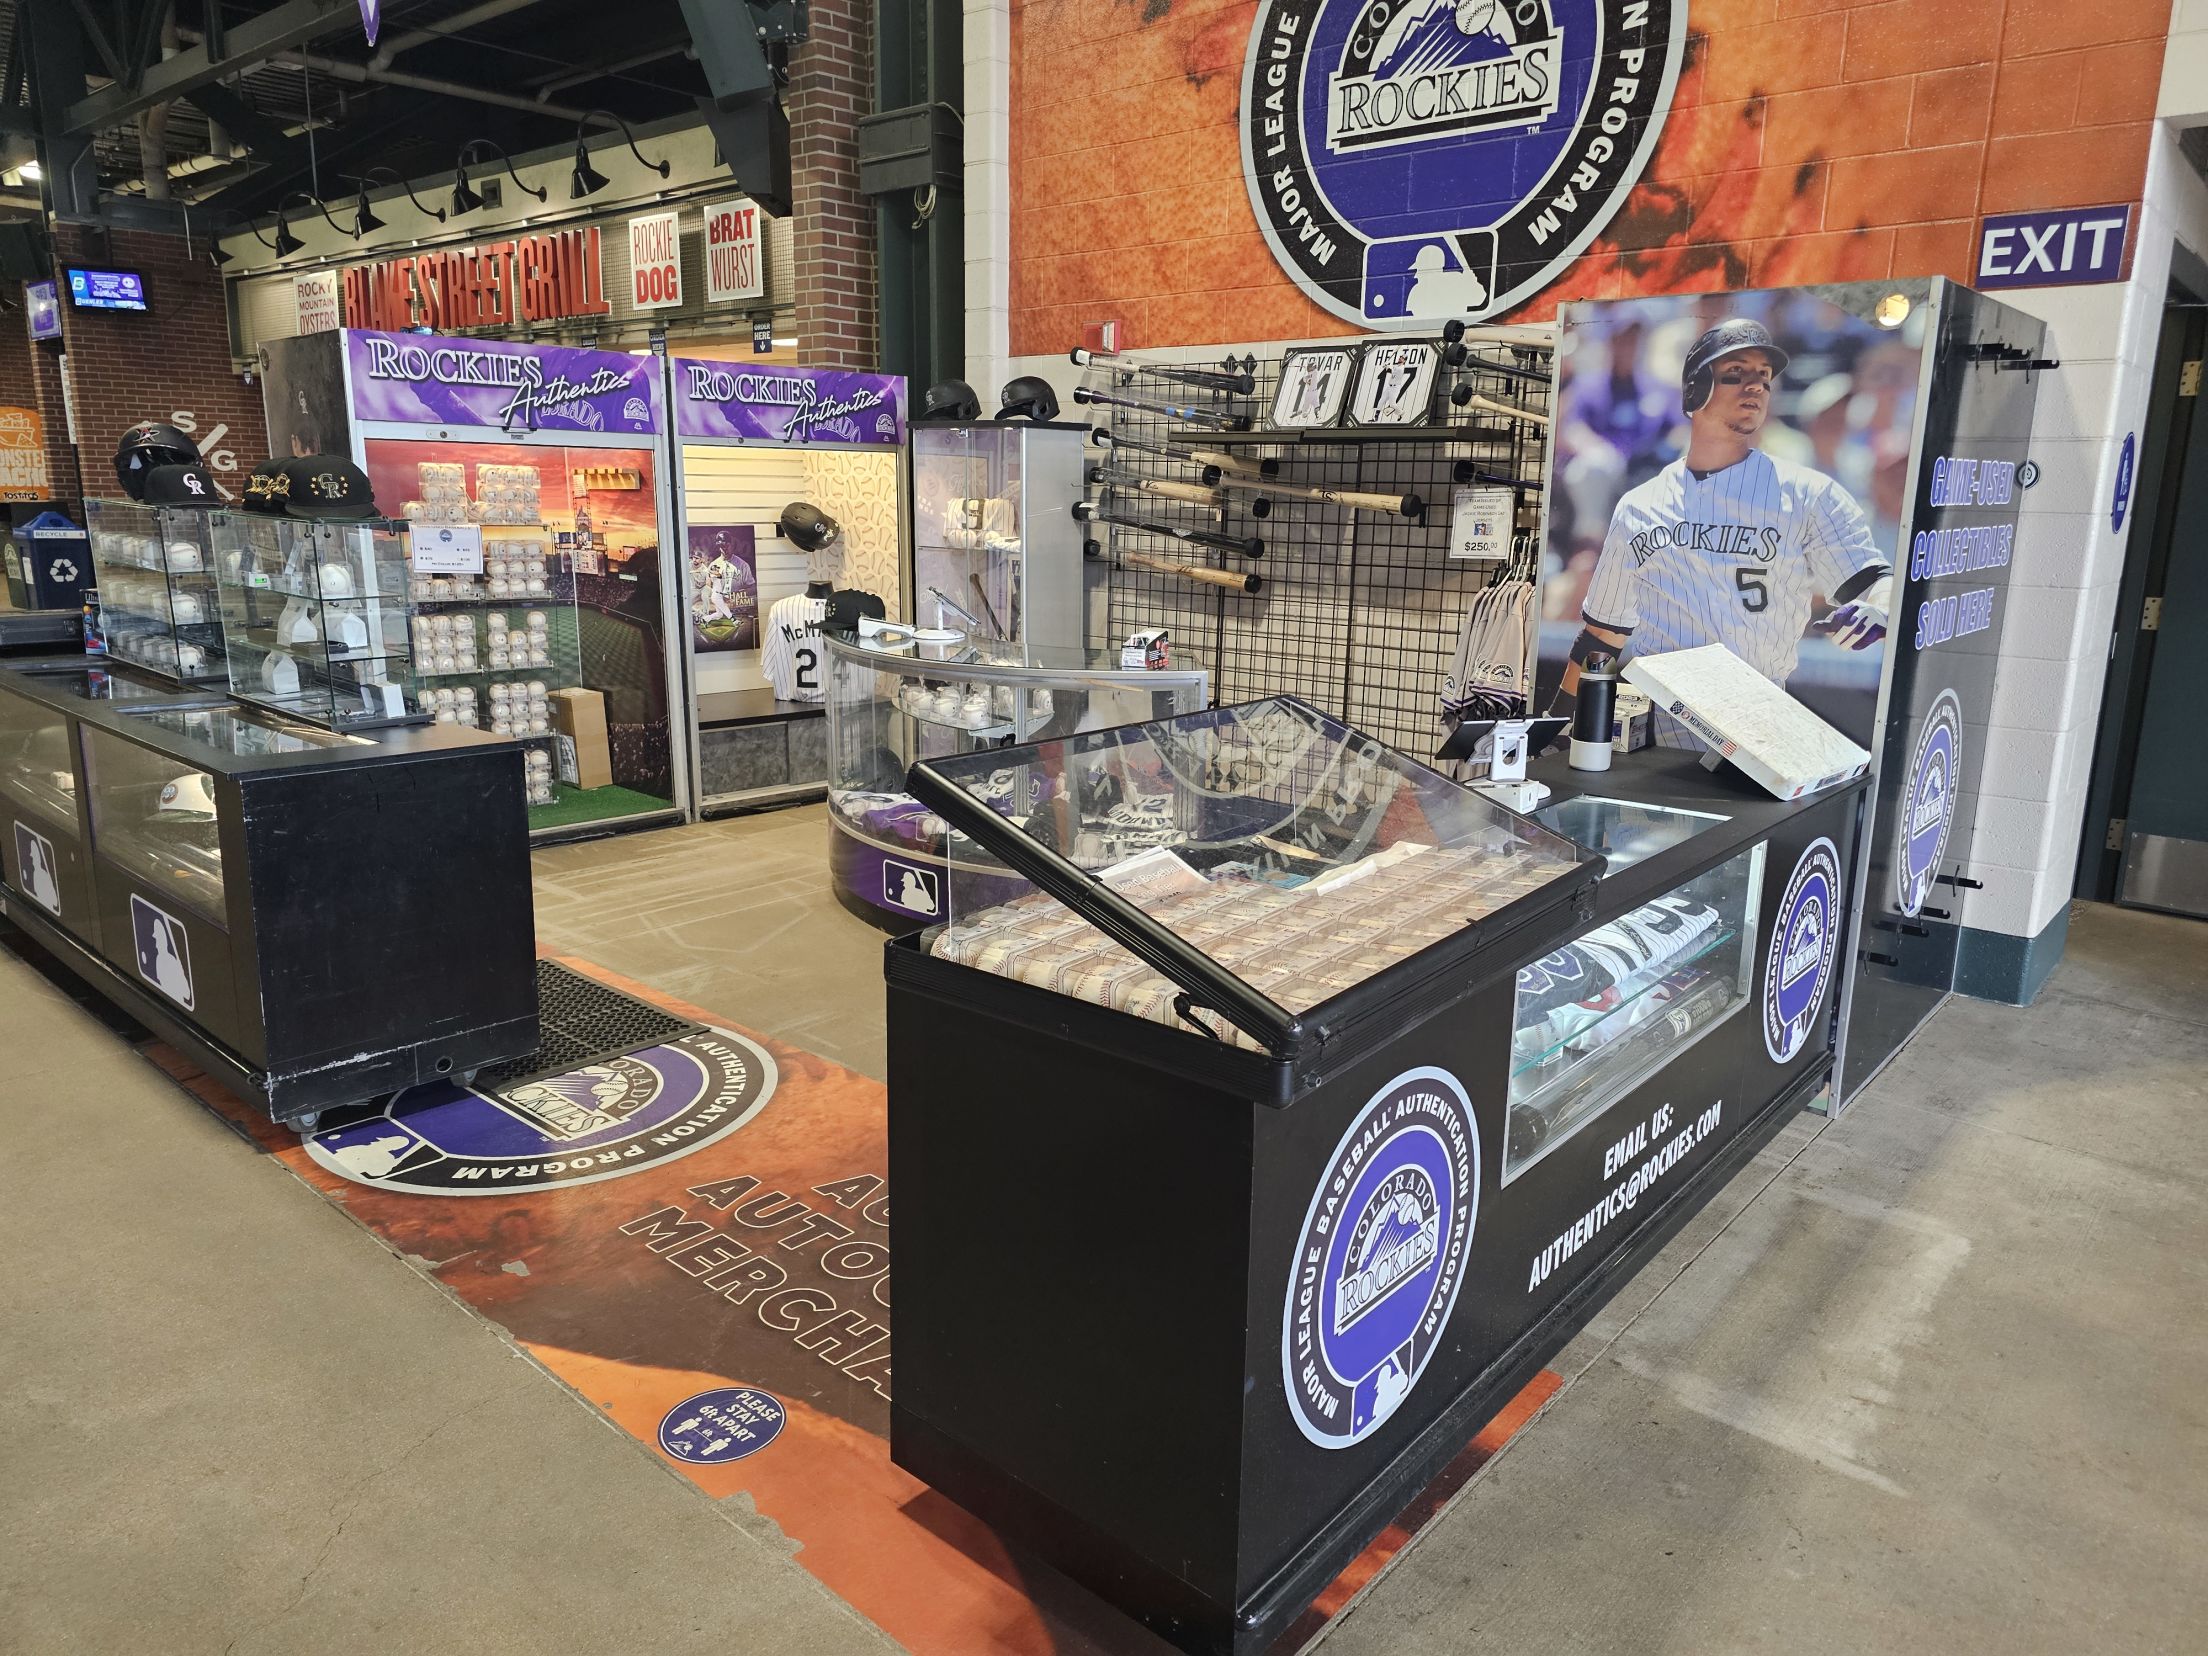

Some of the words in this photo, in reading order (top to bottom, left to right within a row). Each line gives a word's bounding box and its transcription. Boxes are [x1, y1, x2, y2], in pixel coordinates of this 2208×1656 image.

[1264, 12, 1300, 156] LEAGUE
[1336, 46, 1549, 134] ROCKIES
[1527, 47, 1645, 246] PROGRAM
[709, 208, 755, 245] BRAT
[1272, 164, 1338, 266] MAJOR
[633, 219, 674, 265] ROCKIE
[1979, 218, 2124, 277] EXIT
[297, 278, 333, 297] ROCKY
[342, 257, 418, 331] BLAKE
[417, 241, 517, 329] STREET
[518, 227, 612, 321] GRILL
[635, 264, 678, 304] DOG
[711, 243, 755, 292] WURST
[300, 299, 334, 311] MOUNTAIN
[300, 311, 336, 335] OYSTERS
[754, 331, 771, 340] HERE
[1375, 348, 1428, 366] HELTON
[365, 338, 543, 389] ROCKIES
[688, 365, 816, 407] ROCKIES
[1373, 366, 1418, 409] 17
[499, 367, 630, 424] Authentics
[784, 387, 882, 437] Authentics
[1930, 456, 2015, 507] GAME-USED
[1628, 520, 1782, 568] ROCKIES
[1910, 524, 2013, 582] COLLECTIBLES
[729, 590, 748, 602] HALL
[735, 597, 755, 607] FAME
[1735, 566, 1769, 614] 5
[1915, 596, 1957, 650] SOLD
[1955, 587, 1995, 638] HERE
[1688, 716, 1714, 738] MEMORIAL
[1711, 735, 1725, 746] DAY
[1769, 931, 1783, 997] LEAGUE
[1781, 858, 1812, 925] BASEBALL
[1812, 853, 1836, 928] AUTHENTICATION
[507, 1086, 612, 1133] CKIES
[609, 1060, 653, 1110] ORADO
[651, 1041, 746, 1146] AUTHENTICATION
[452, 1143, 646, 1180] PROGRAM
[1394, 1093, 1470, 1199] AUTHENTICATION
[1604, 1121, 1648, 1181] EMAIL
[1652, 1102, 1674, 1140] US:
[1316, 1112, 1391, 1234] BASEBALL
[1527, 1099, 1722, 1294] AUTHENTICS@ROCKIES.COM
[1349, 1172, 1433, 1263] COLORADO
[1340, 1220, 1437, 1318] ROCKIES
[1424, 1204, 1468, 1337] PROGRAM
[1298, 1246, 1322, 1360] LEAGUE
[726, 1403, 760, 1425] STAY
[735, 1391, 781, 1422] PLEASE
[1303, 1361, 1339, 1420] MAJOR
[699, 1405, 718, 1418] 6ft
[712, 1415, 756, 1442] APART
